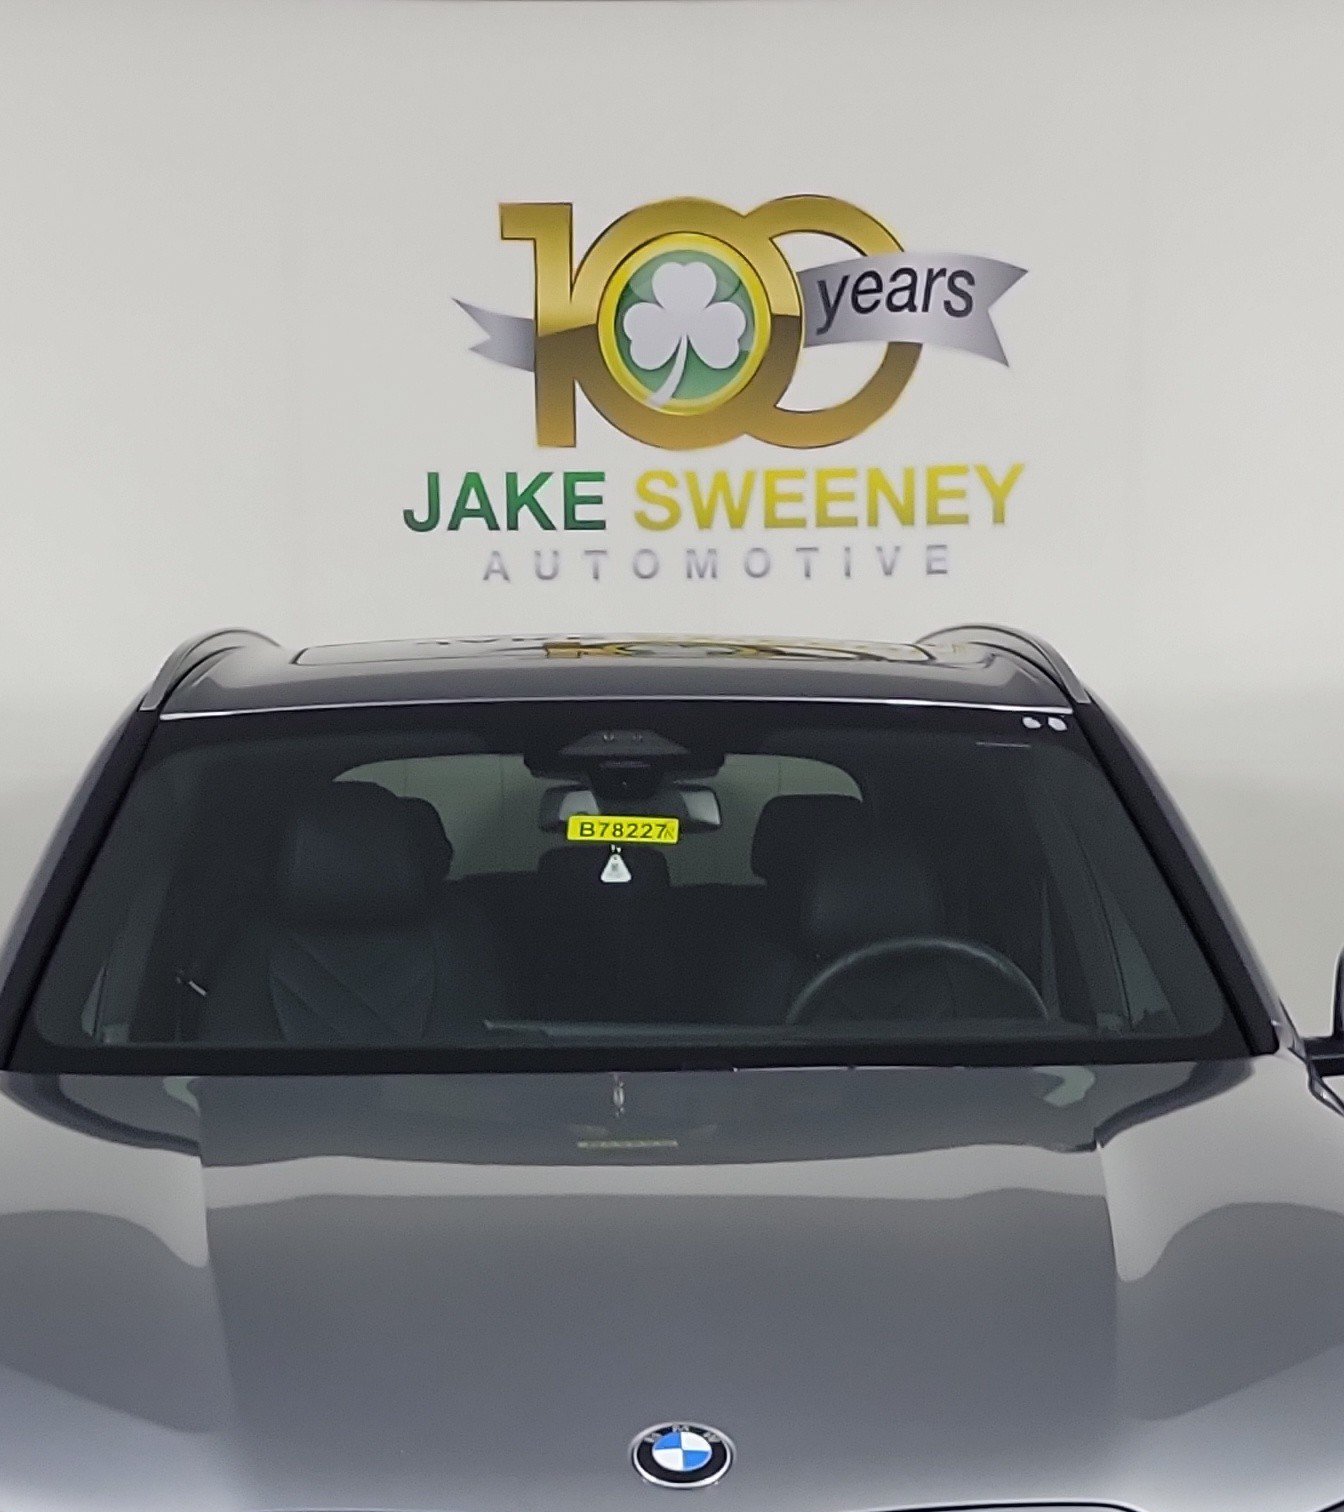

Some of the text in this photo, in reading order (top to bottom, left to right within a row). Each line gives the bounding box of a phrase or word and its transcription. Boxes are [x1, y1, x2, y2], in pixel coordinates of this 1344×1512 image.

[498, 194, 977, 450] 100 years
[403, 463, 1025, 532] JAKE SWEENEY
[483, 544, 950, 582] AUTOMOTIVE
